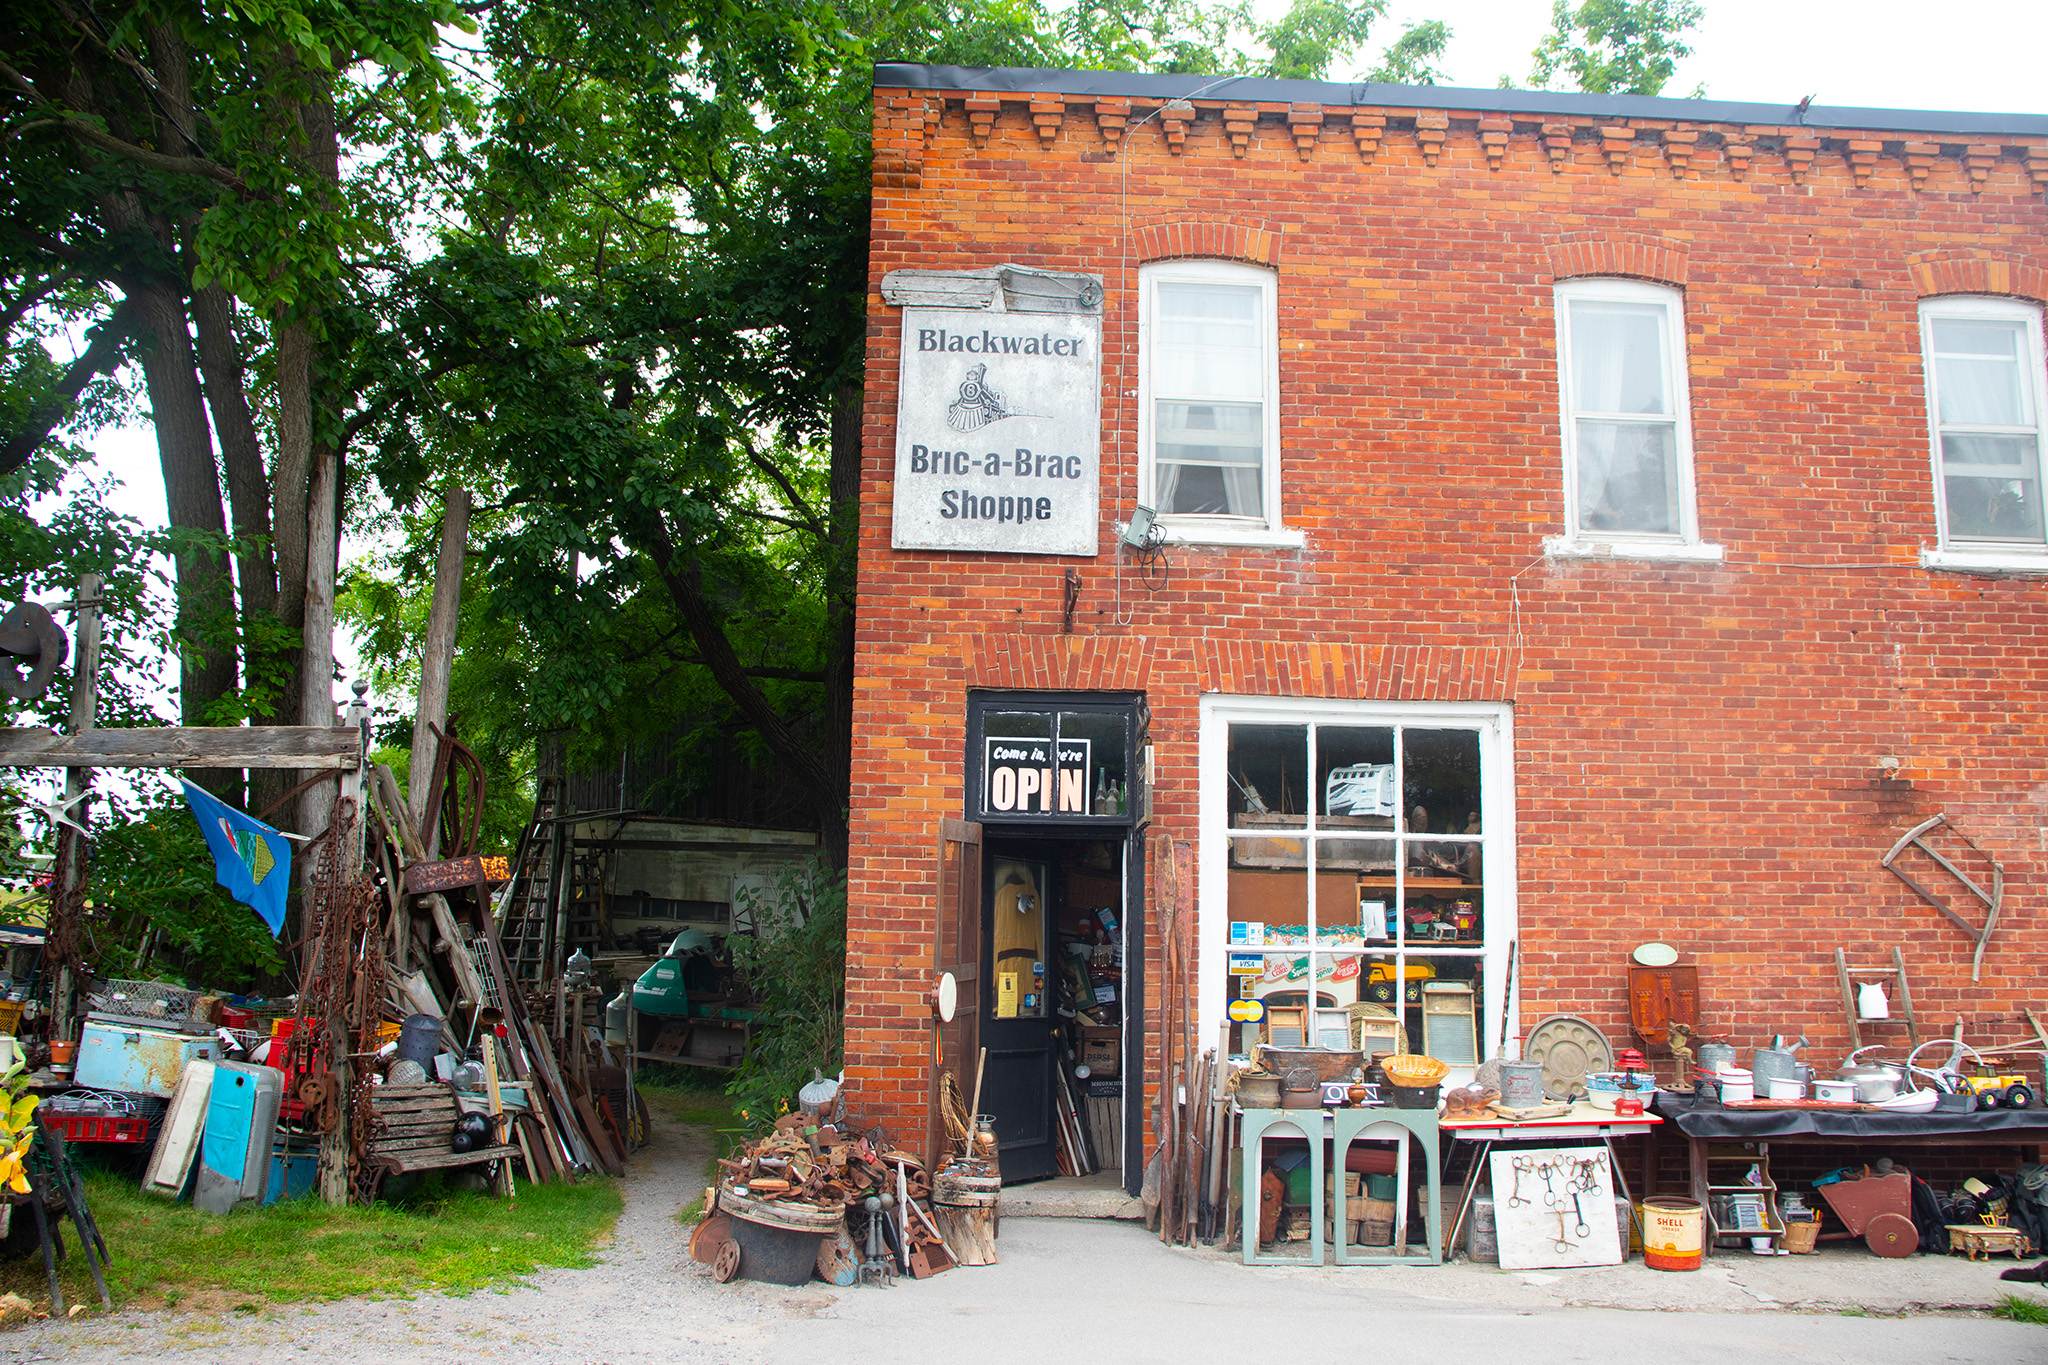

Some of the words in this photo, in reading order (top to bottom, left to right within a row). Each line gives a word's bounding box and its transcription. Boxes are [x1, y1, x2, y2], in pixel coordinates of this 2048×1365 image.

[918, 328, 1083, 357] Blackwater
[911, 444, 1081, 480] Bric-a-Brac
[940, 489, 1052, 525] Shoppe
[993, 746, 1028, 760] Come
[1030, 747, 1046, 762] in,
[1050, 749, 1083, 761] e're
[1326, 1086, 1378, 1101] ON
[1657, 1217, 1683, 1227] SHELL
